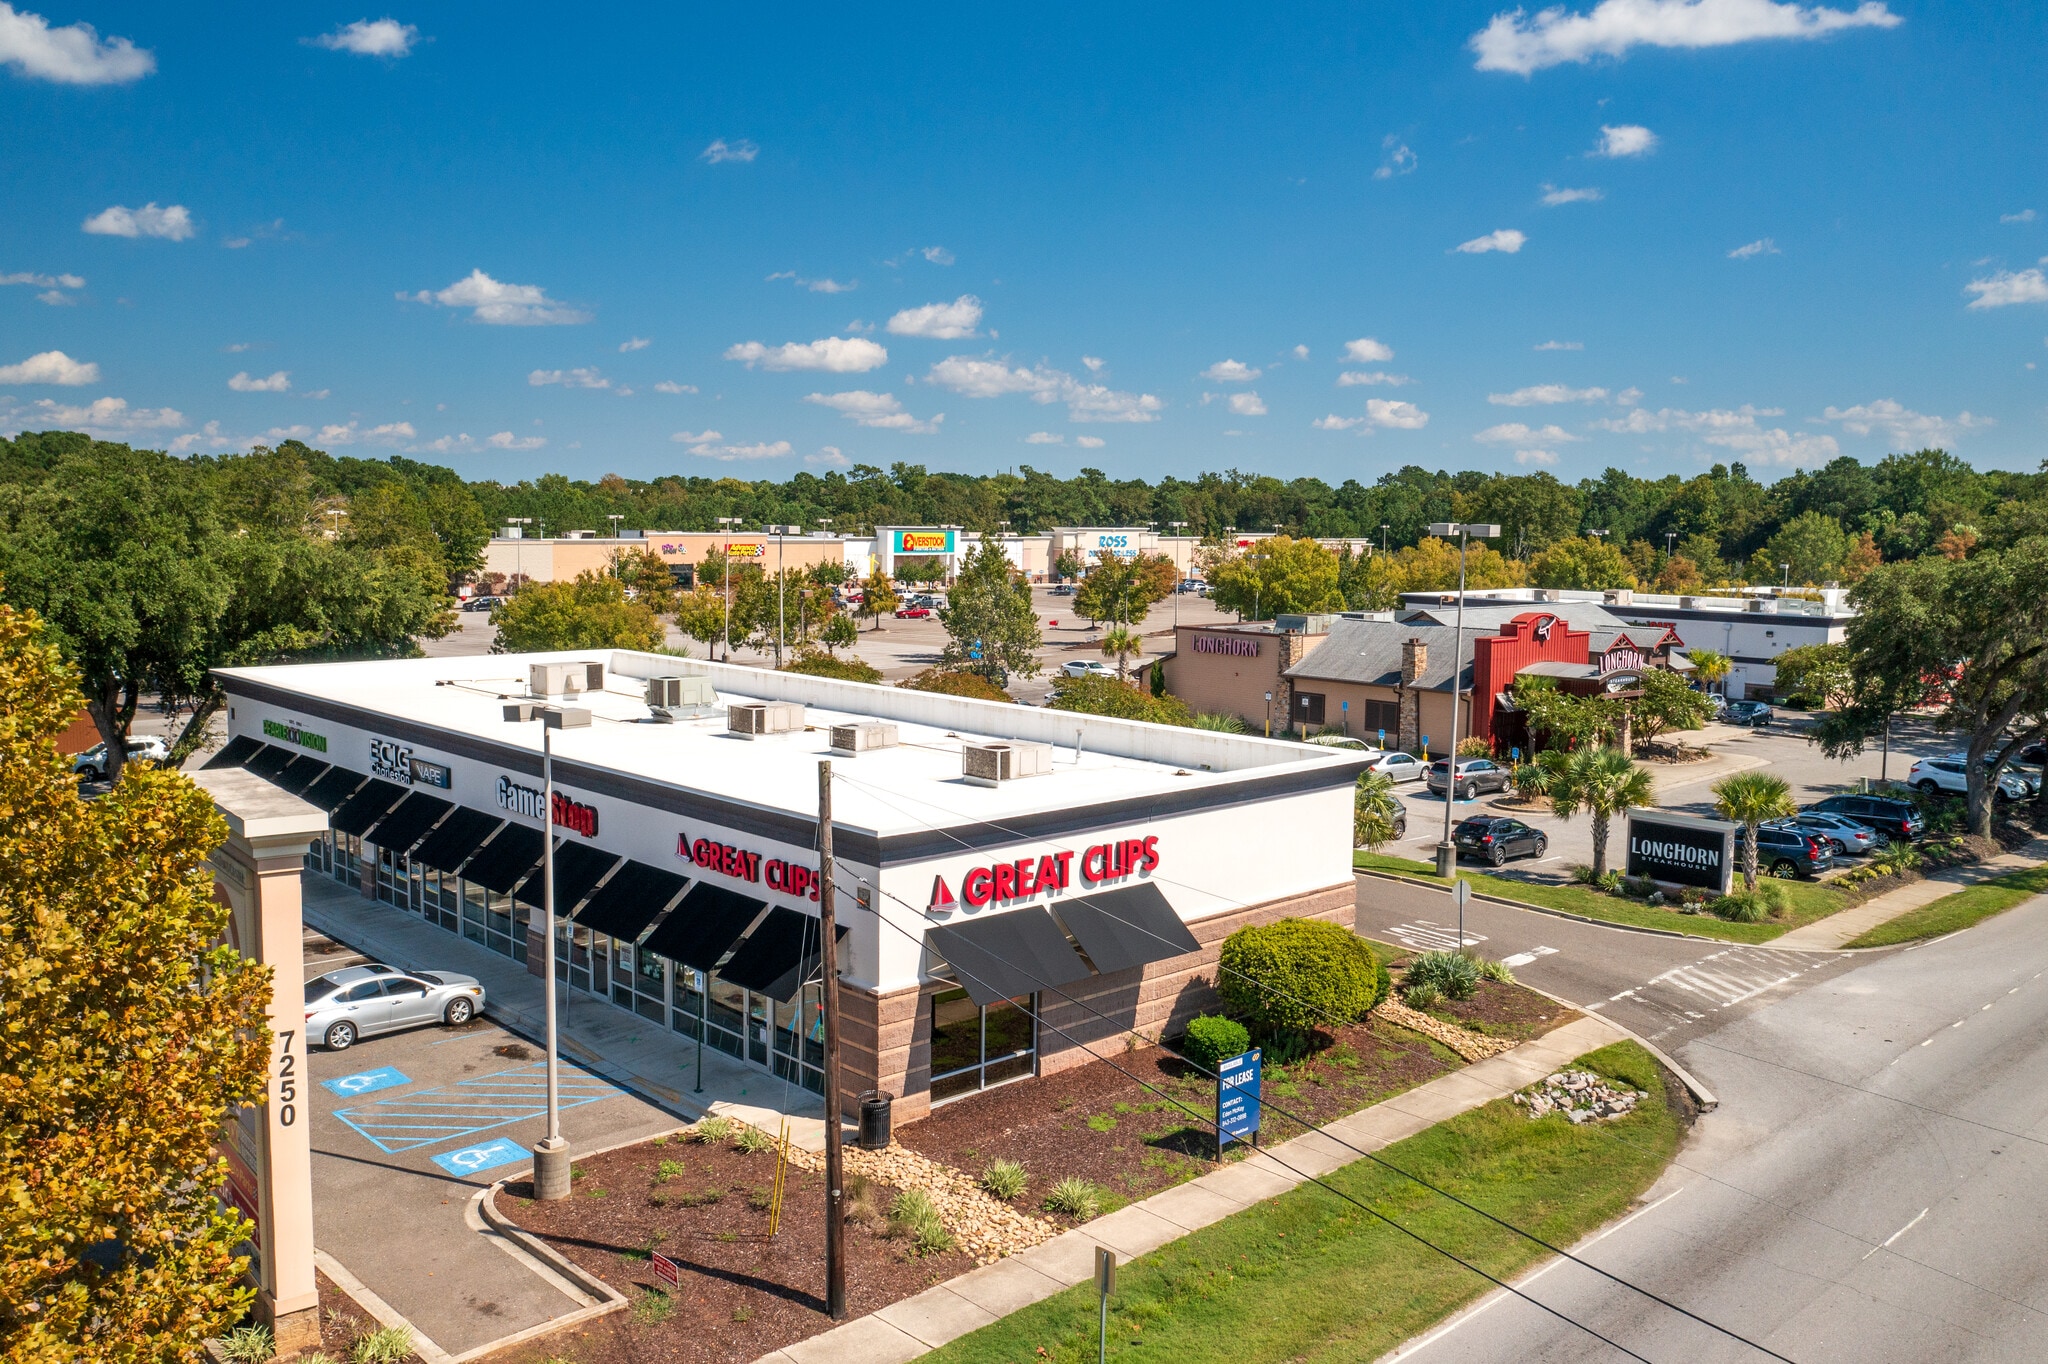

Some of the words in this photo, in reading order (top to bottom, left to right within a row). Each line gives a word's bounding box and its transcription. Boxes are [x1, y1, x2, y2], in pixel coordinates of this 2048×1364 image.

[903, 533, 945, 551] OVERSTOCK
[1099, 535, 1127, 547] ROSS
[1191, 634, 1259, 657] LONGHORN
[1599, 649, 1645, 674] LONGHORN
[300, 730, 328, 753] VISION
[369, 738, 412, 772] ECIG
[370, 762, 412, 785] Charleston
[415, 762, 442, 784] VAPE
[495, 776, 597, 838] GameStop
[1631, 836, 1719, 866] LONGHORN
[693, 838, 761, 883] GREAT
[764, 858, 820, 902] CLIPS
[963, 850, 1074, 906] GREAT
[1082, 835, 1159, 882] CLIPS
[1641, 856, 1707, 871] STEAKHOUSE
[279, 1030, 296, 1127] 7250
[1223, 1076, 1234, 1090] FOR
[1235, 1069, 1253, 1085] LEASE
[1222, 1097, 1242, 1108] CONTACT:
